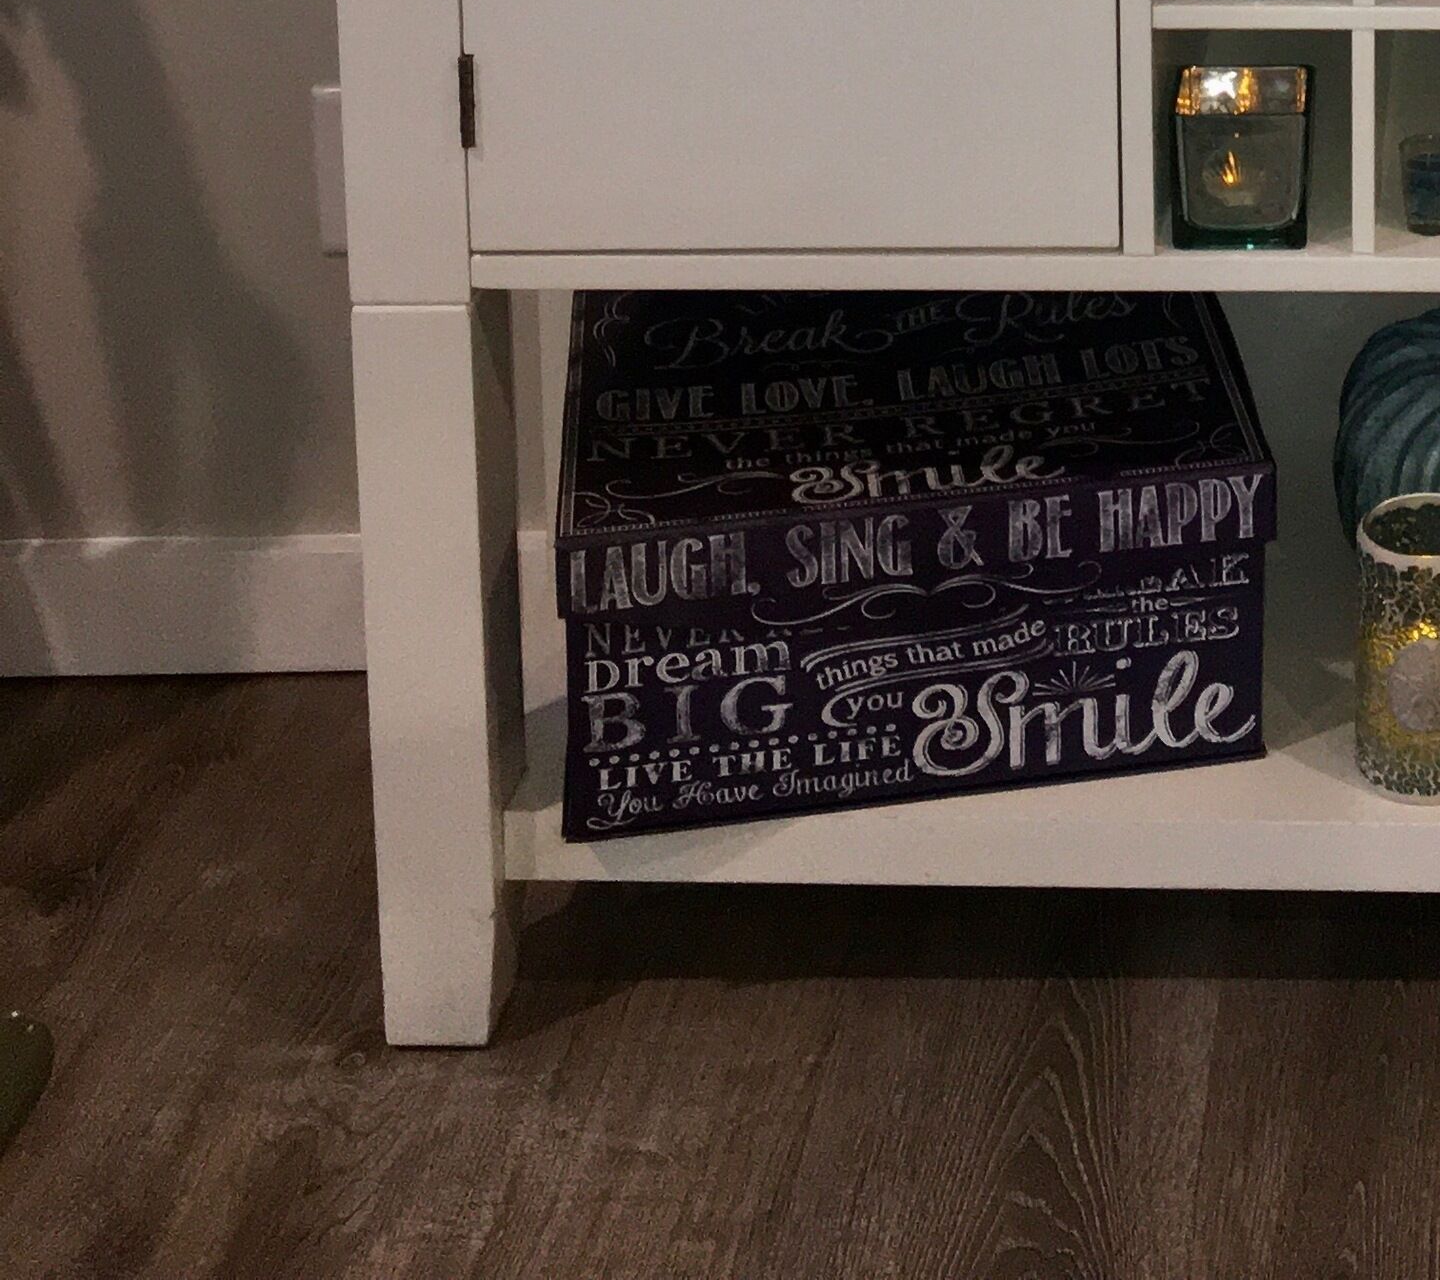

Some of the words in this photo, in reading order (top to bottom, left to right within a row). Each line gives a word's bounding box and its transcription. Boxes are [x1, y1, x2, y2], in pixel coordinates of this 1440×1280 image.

[596, 384, 714, 421] GIVE
[897, 352, 1063, 401] LAUGH
[1080, 336, 1200, 380] LOTS
[586, 423, 866, 462] NEVER
[904, 375, 1211, 438] REGRET
[789, 443, 1066, 505] Smile
[568, 531, 762, 613] LAUGH,
[785, 514, 914, 588] SING
[937, 505, 984, 569] &
[1007, 493, 1073, 563] BE
[1097, 473, 1264, 553] HAPPY
[1053, 605, 1241, 657] RULES
[1131, 595, 1170, 614] the
[815, 653, 898, 692] things
[906, 641, 966, 667] that
[973, 618, 1047, 653] made
[580, 674, 794, 754] BIG
[844, 689, 904, 720] you
[911, 648, 1257, 778] Smile
[586, 791, 664, 831] You
[672, 781, 765, 811] Have
[772, 758, 915, 799] Imagined
[598, 759, 693, 792] LIVE
[711, 747, 793, 778] THE
[813, 735, 902, 766] LIFE
